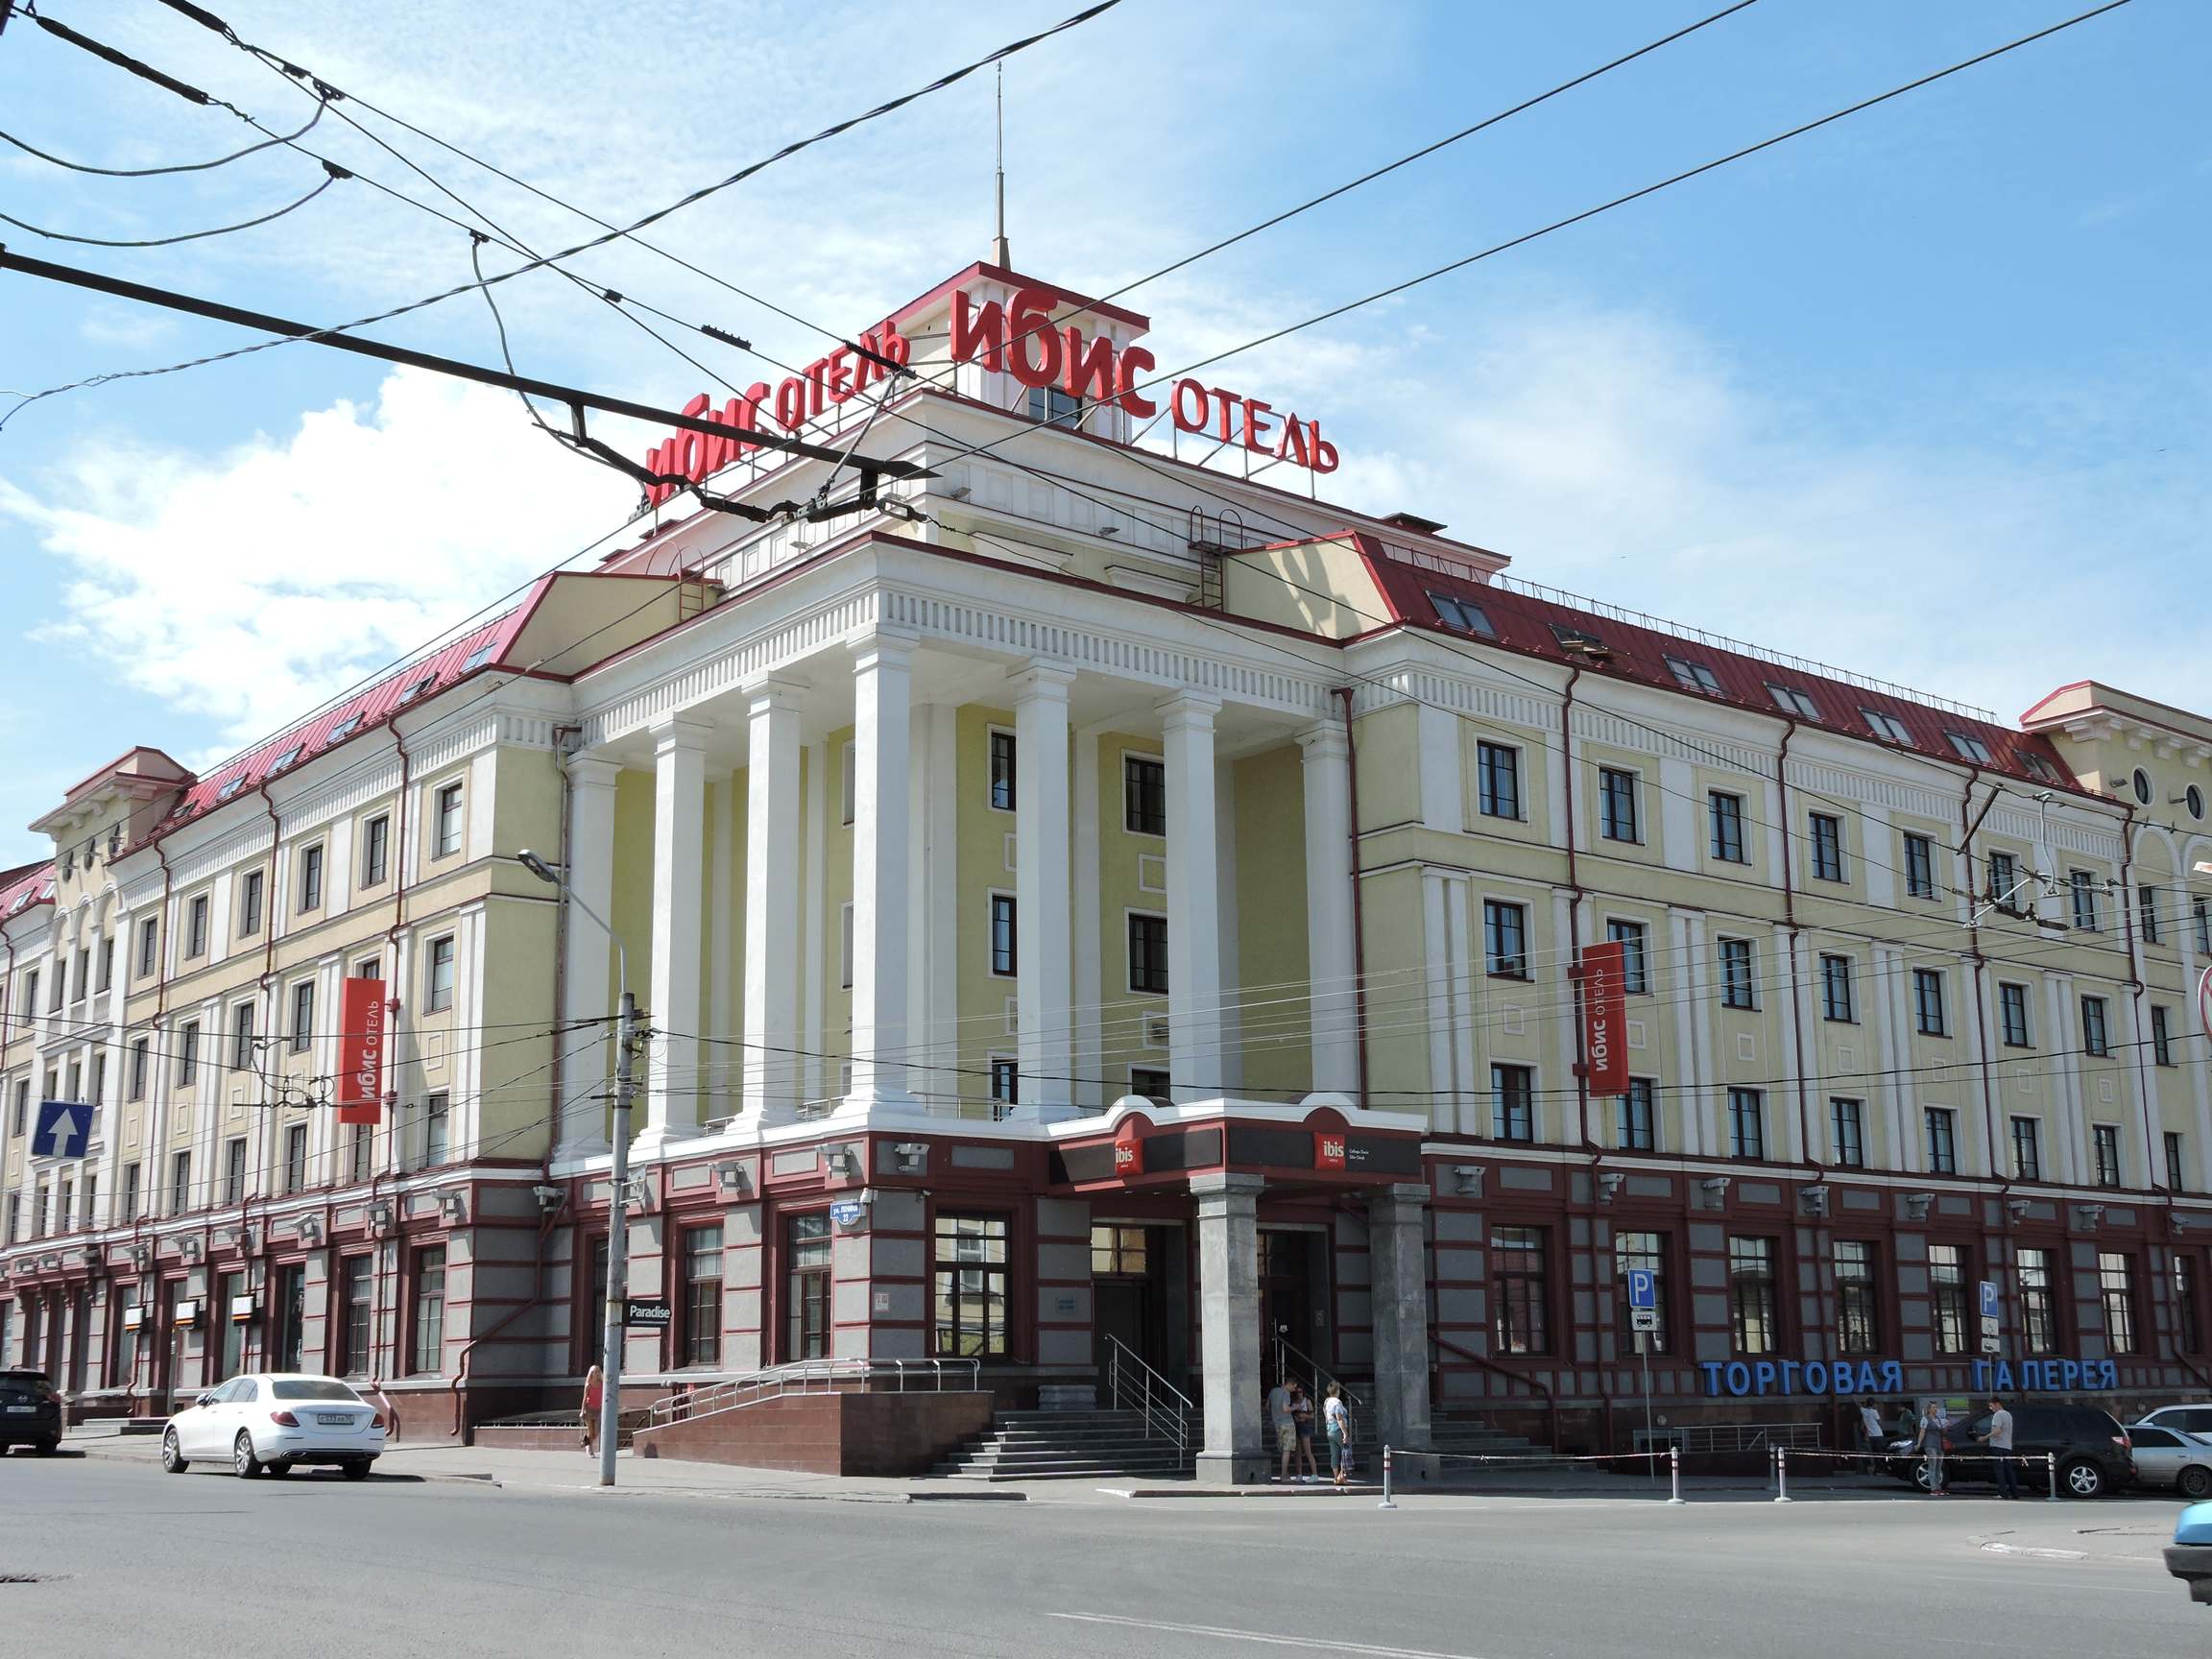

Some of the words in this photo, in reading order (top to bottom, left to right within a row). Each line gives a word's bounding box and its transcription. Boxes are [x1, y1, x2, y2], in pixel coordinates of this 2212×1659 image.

[1170, 377, 1339, 474] ОТЕЛЬ
[1594, 969, 1605, 1016] ОТЕЛЬ
[366, 1000, 378, 1046] ОТЕЛЬ
[1592, 1020, 1608, 1071] ибис
[356, 1049, 377, 1099] ибис
[1115, 1146, 1134, 1164] ibis
[1323, 1141, 1345, 1158] ibis
[629, 1305, 670, 1318] Paradise
[1699, 1359, 1905, 1396] ТОРГОВАЯ
[1971, 1358, 2119, 1391] ГАЛЕРЕЯ
